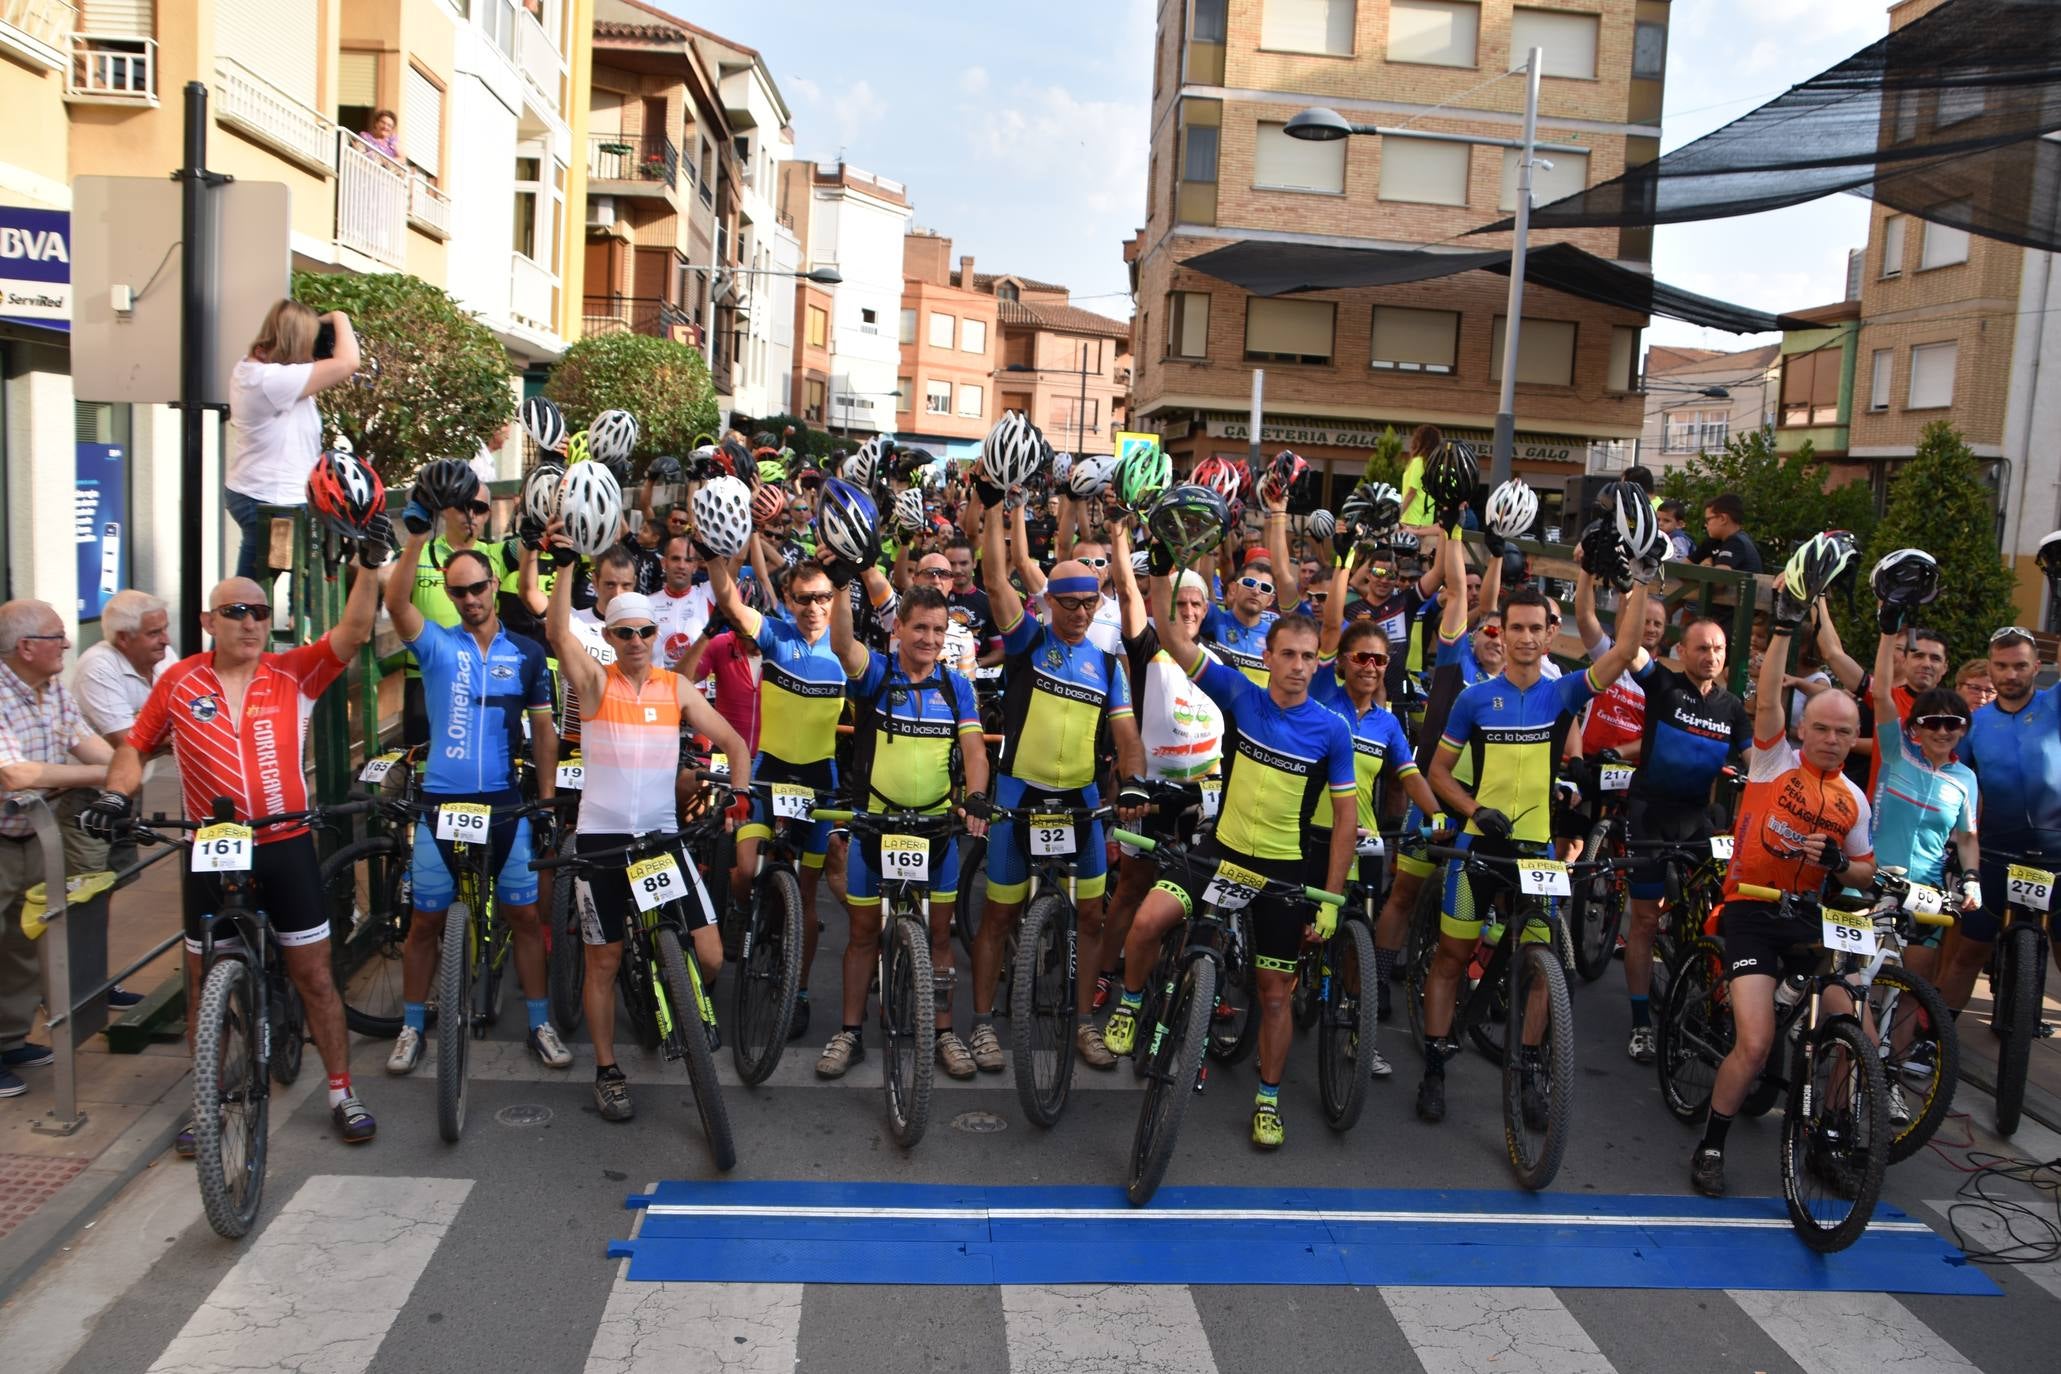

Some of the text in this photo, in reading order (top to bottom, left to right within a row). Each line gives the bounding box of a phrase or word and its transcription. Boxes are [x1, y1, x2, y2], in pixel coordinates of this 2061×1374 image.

[8, 294, 64, 309] ServiRed
[1224, 425, 1328, 442] CAETERIA
[1525, 447, 1570, 460] GALO
[792, 681, 801, 691] la
[1054, 682, 1064, 694] la
[1065, 687, 1103, 704] bascula
[901, 723, 911, 733] la
[913, 724, 951, 736] bascula
[1504, 732, 1514, 741] la
[1515, 731, 1550, 742] bascula
[1253, 748, 1263, 760] la
[1264, 754, 1307, 773] bascula
[561, 767, 582, 778] 19
[1603, 770, 1630, 780] 217
[445, 813, 484, 829] 196
[1040, 828, 1065, 842] 32
[201, 839, 242, 855] 161
[884, 839, 927, 850] LA PERA
[887, 851, 924, 867] 169
[630, 858, 674, 880] LA PERA
[1531, 871, 1557, 883] 97
[643, 872, 671, 893] 88
[1235, 870, 1264, 888] PERA
[1214, 878, 1256, 900] 228
[2011, 880, 2047, 898] 278
[1825, 911, 1871, 928] LA PERA
[1835, 925, 1863, 941] 59
